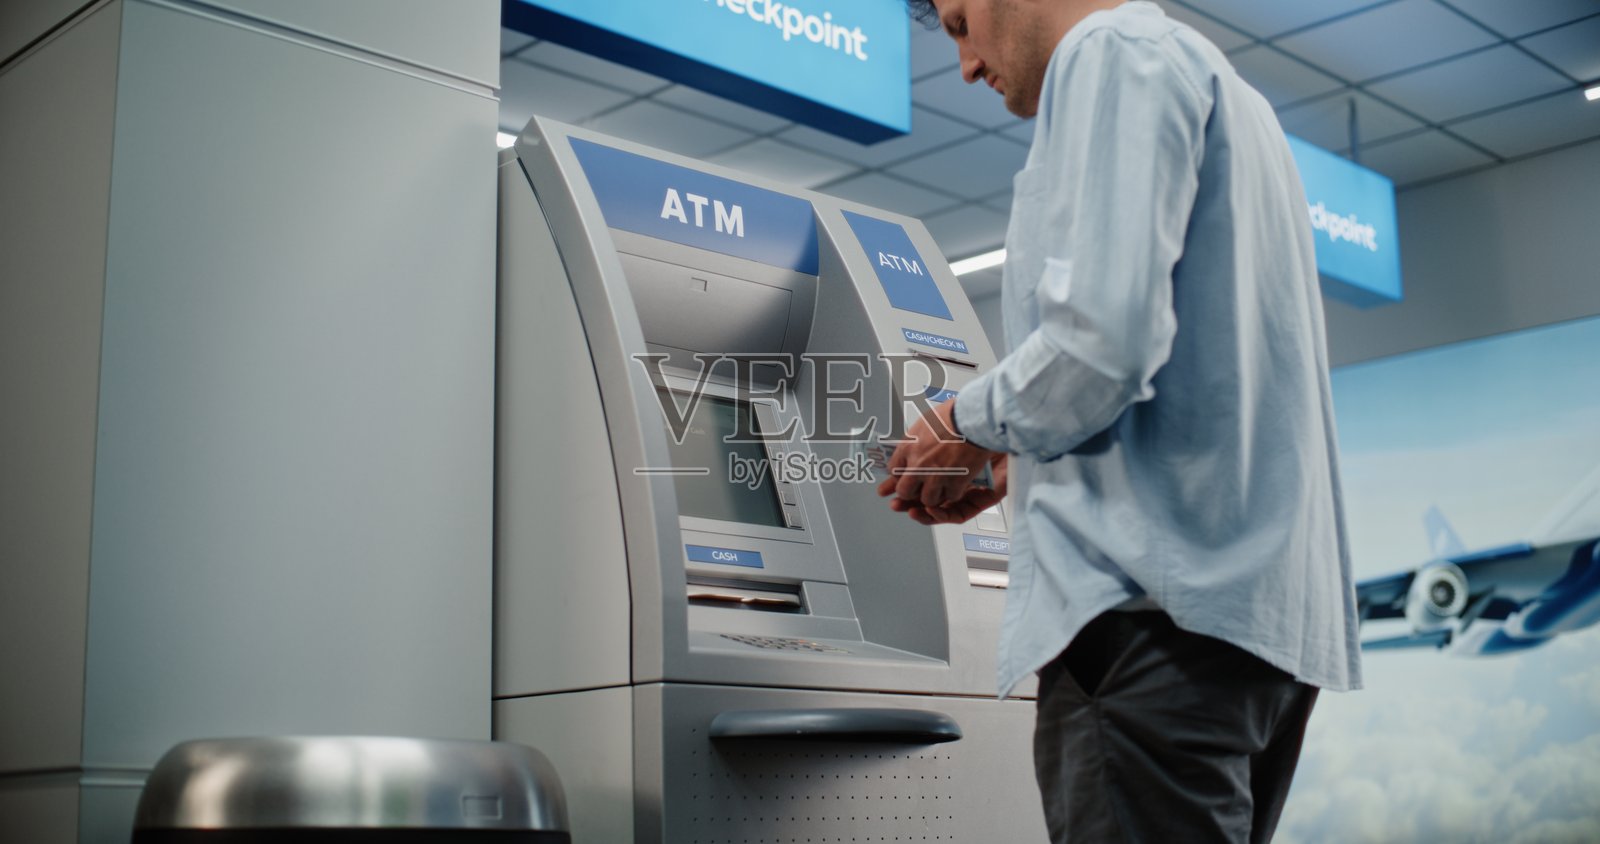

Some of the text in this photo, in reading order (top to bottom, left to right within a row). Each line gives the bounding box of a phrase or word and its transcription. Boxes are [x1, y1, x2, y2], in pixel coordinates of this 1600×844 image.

[704, 0, 868, 61] eckpoint
[660, 187, 745, 238] ATM
[1307, 201, 1377, 252] ckpoint
[878, 251, 924, 277] ATM
[905, 331, 965, 350] CASH/CHECK IN
[711, 551, 738, 562] CASH
